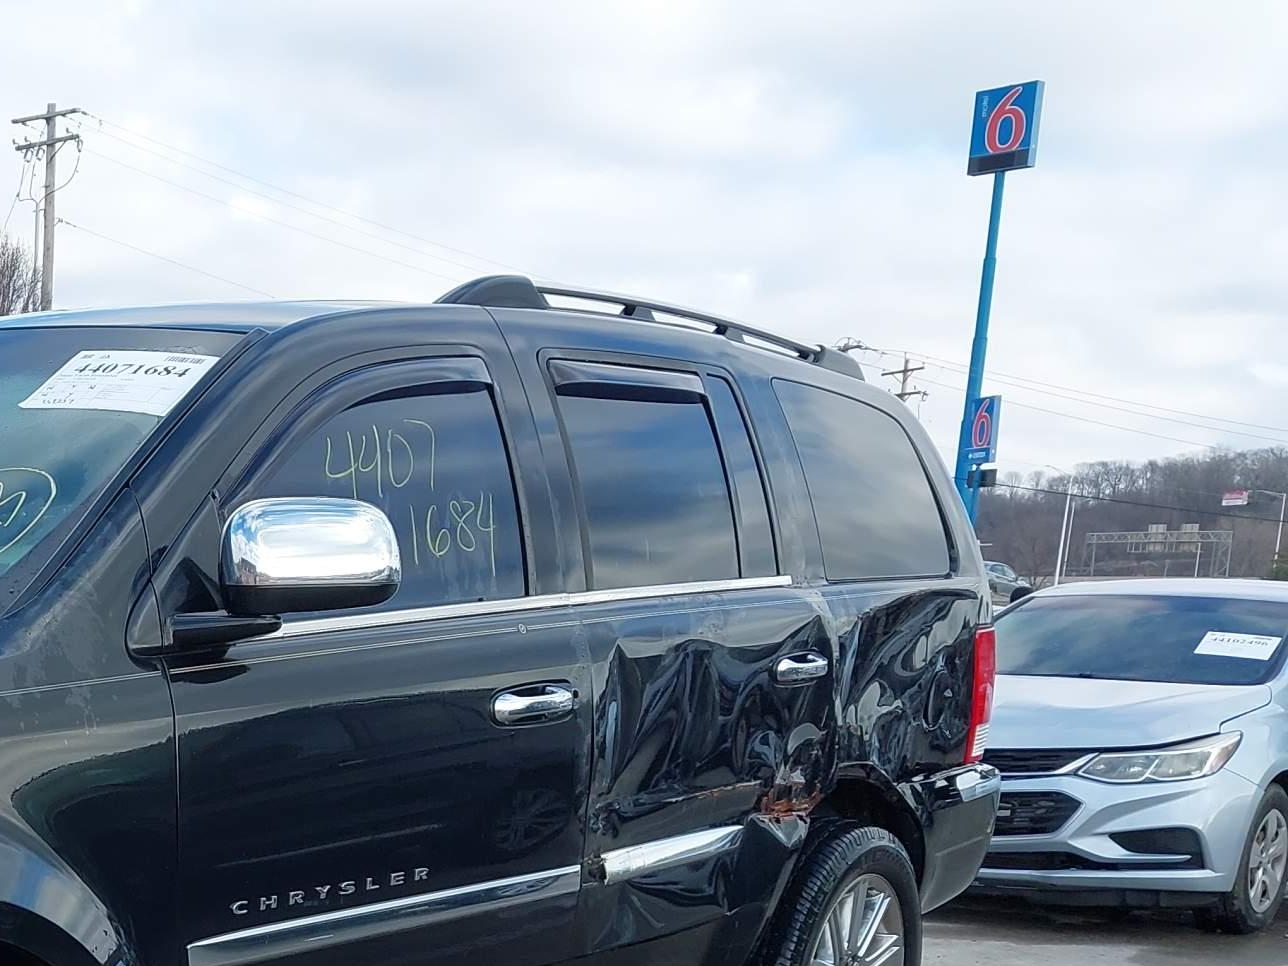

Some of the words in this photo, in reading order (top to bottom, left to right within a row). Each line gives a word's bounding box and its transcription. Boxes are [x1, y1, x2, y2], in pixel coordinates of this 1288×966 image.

[985, 87, 1026, 153] 6
[74, 362, 192, 378] 44071684
[973, 399, 991, 447] 6
[325, 418, 435, 500] 4407
[409, 490, 497, 577] 1684
[230, 866, 430, 915] CHRYSLER
